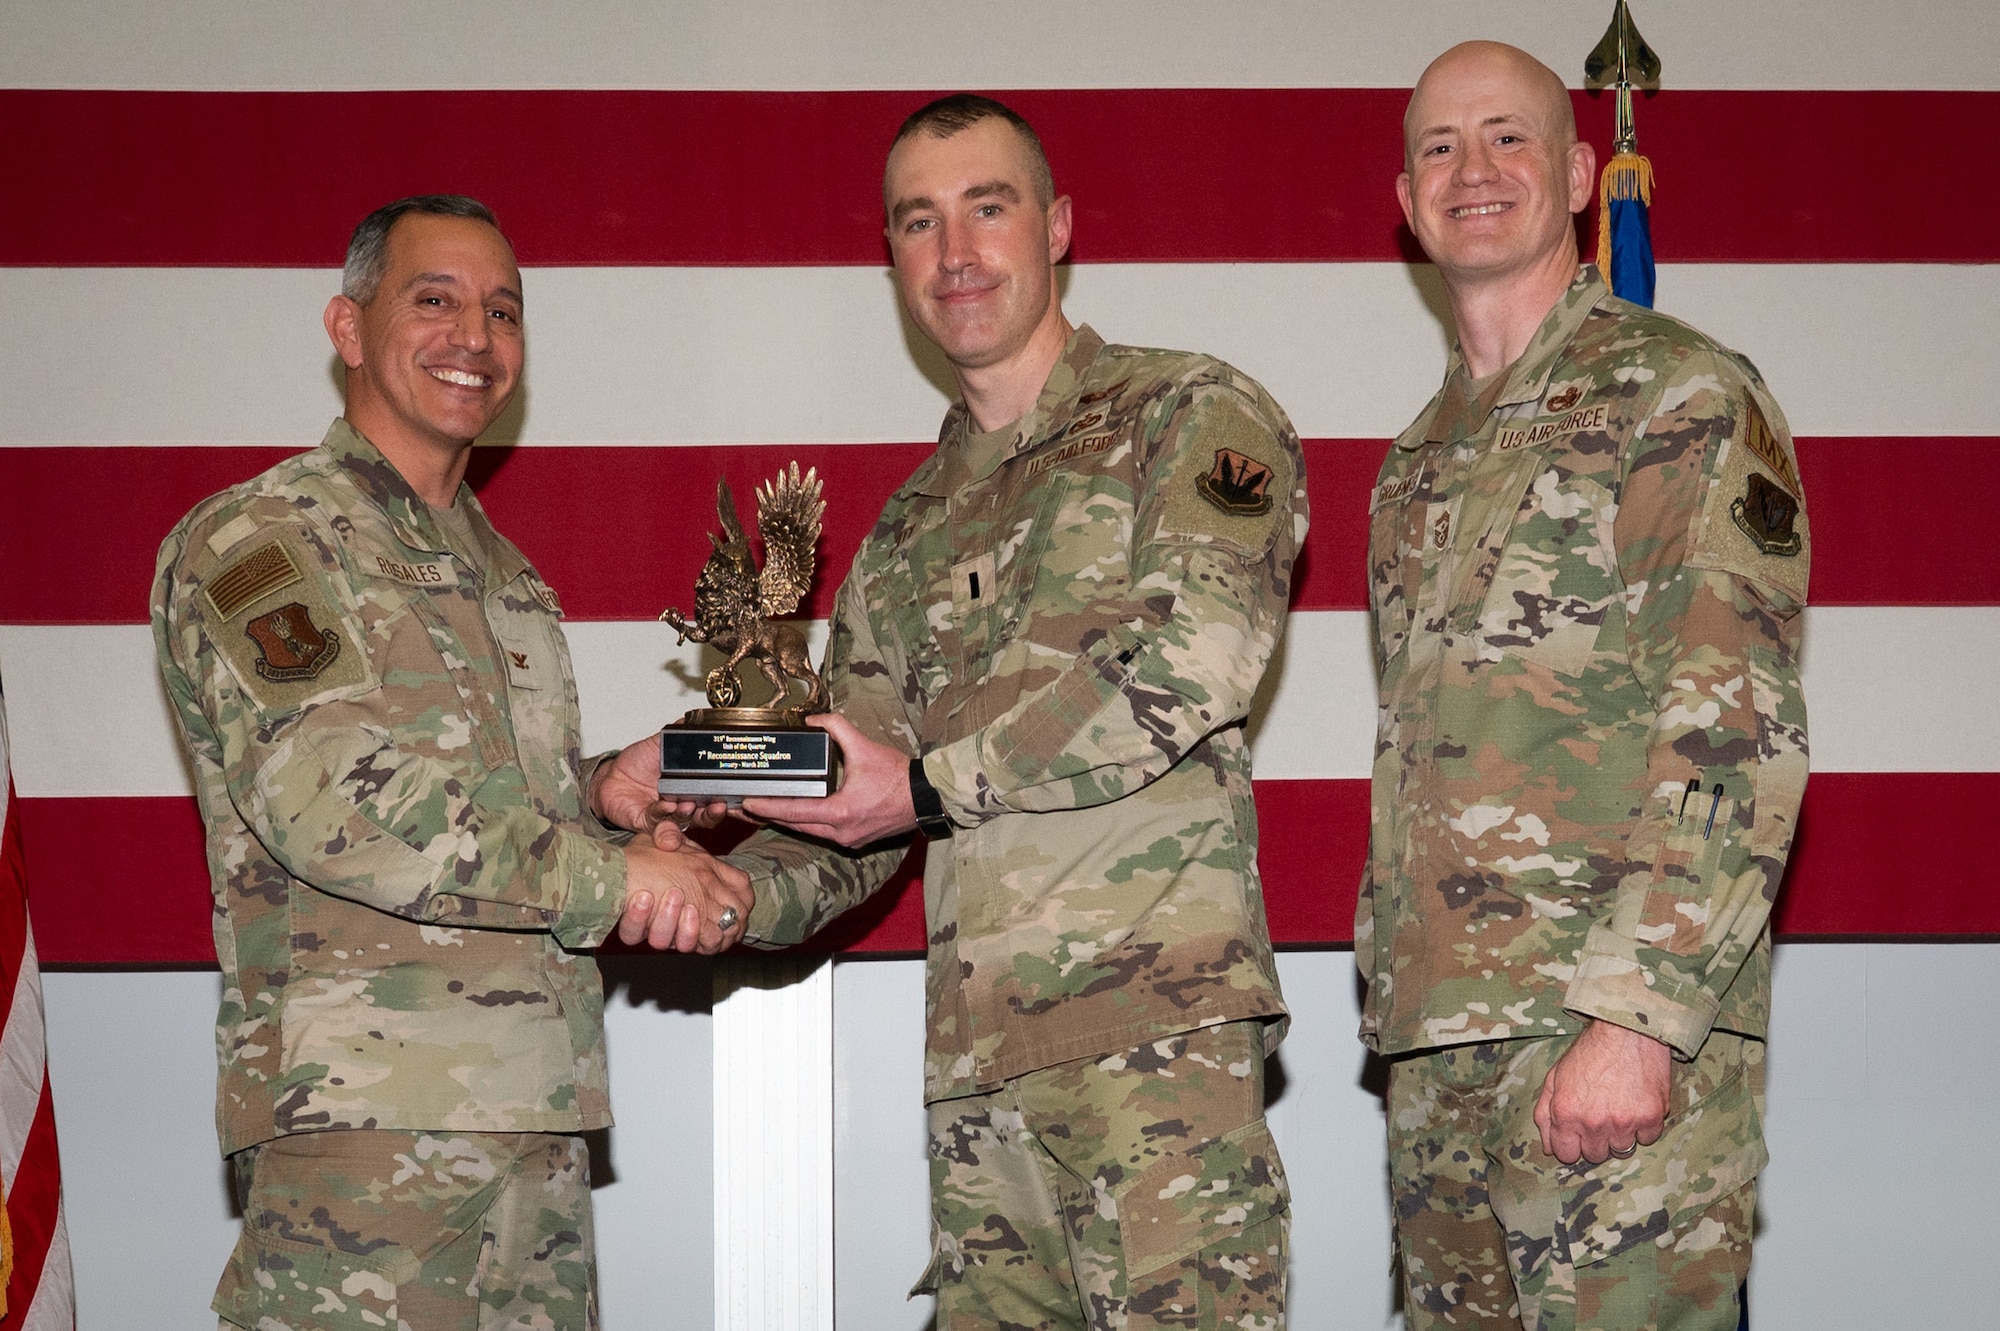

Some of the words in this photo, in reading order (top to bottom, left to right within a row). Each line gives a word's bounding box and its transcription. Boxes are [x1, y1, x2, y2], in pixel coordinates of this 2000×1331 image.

[1525, 424, 1556, 445] AIR
[1553, 407, 1604, 436] FORCE
[1055, 442, 1078, 463] AIR
[1081, 427, 1122, 455] FORC
[725, 735, 763, 743] Reconnaissance
[762, 735, 777, 744] Wing
[747, 743, 767, 751] Quarter
[707, 751, 759, 760] Reconnaissance
[759, 750, 792, 762] Squadron
